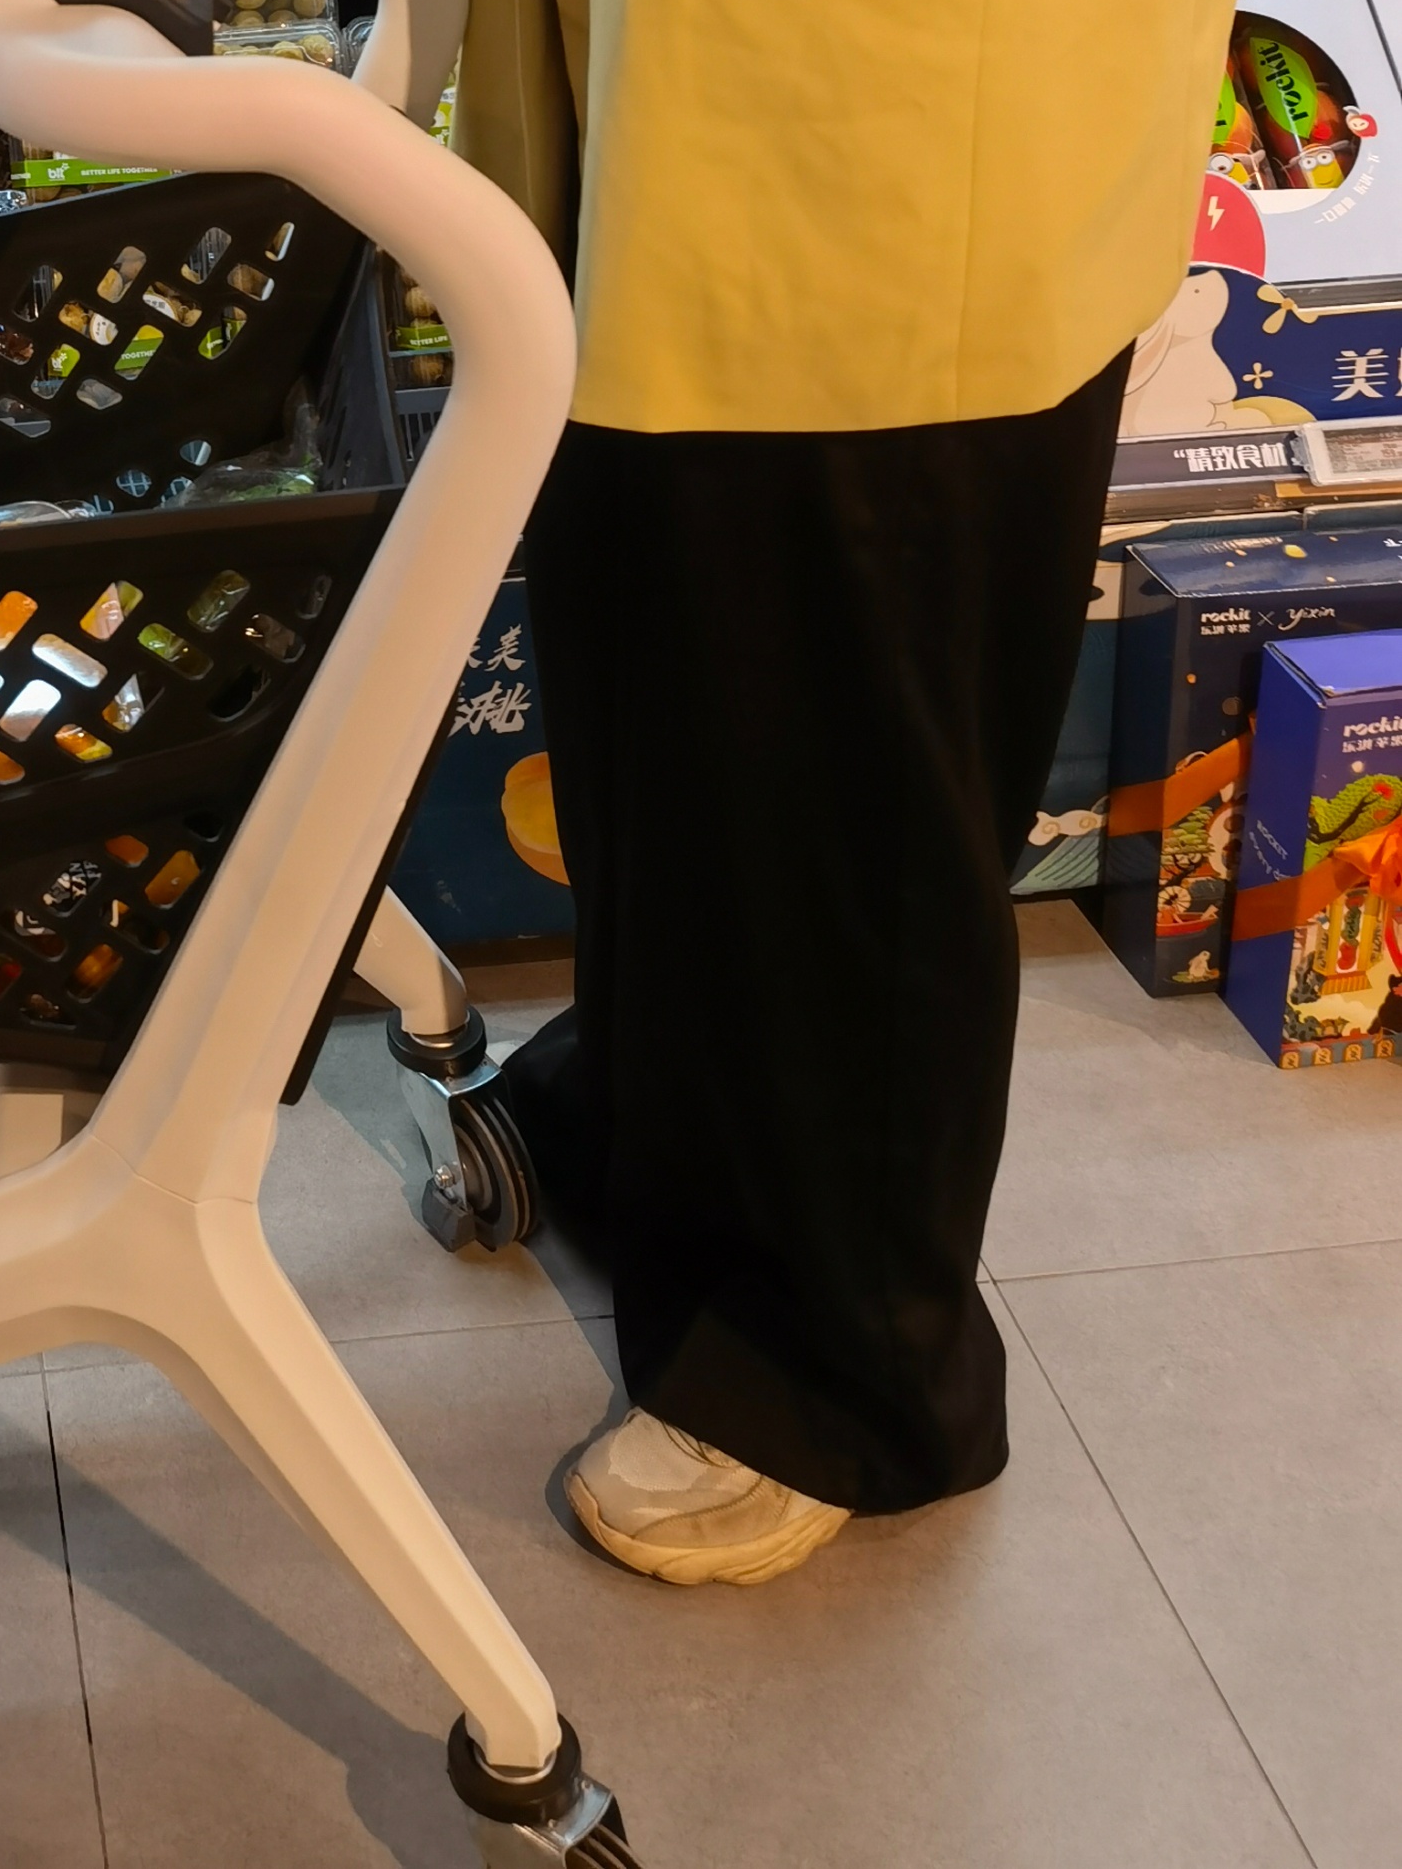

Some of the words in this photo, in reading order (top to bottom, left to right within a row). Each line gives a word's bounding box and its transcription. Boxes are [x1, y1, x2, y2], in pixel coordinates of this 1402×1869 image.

[1258, 41, 1309, 122] rockit
[1331, 347, 1402, 402] 美
[1201, 608, 1251, 624] rockit
